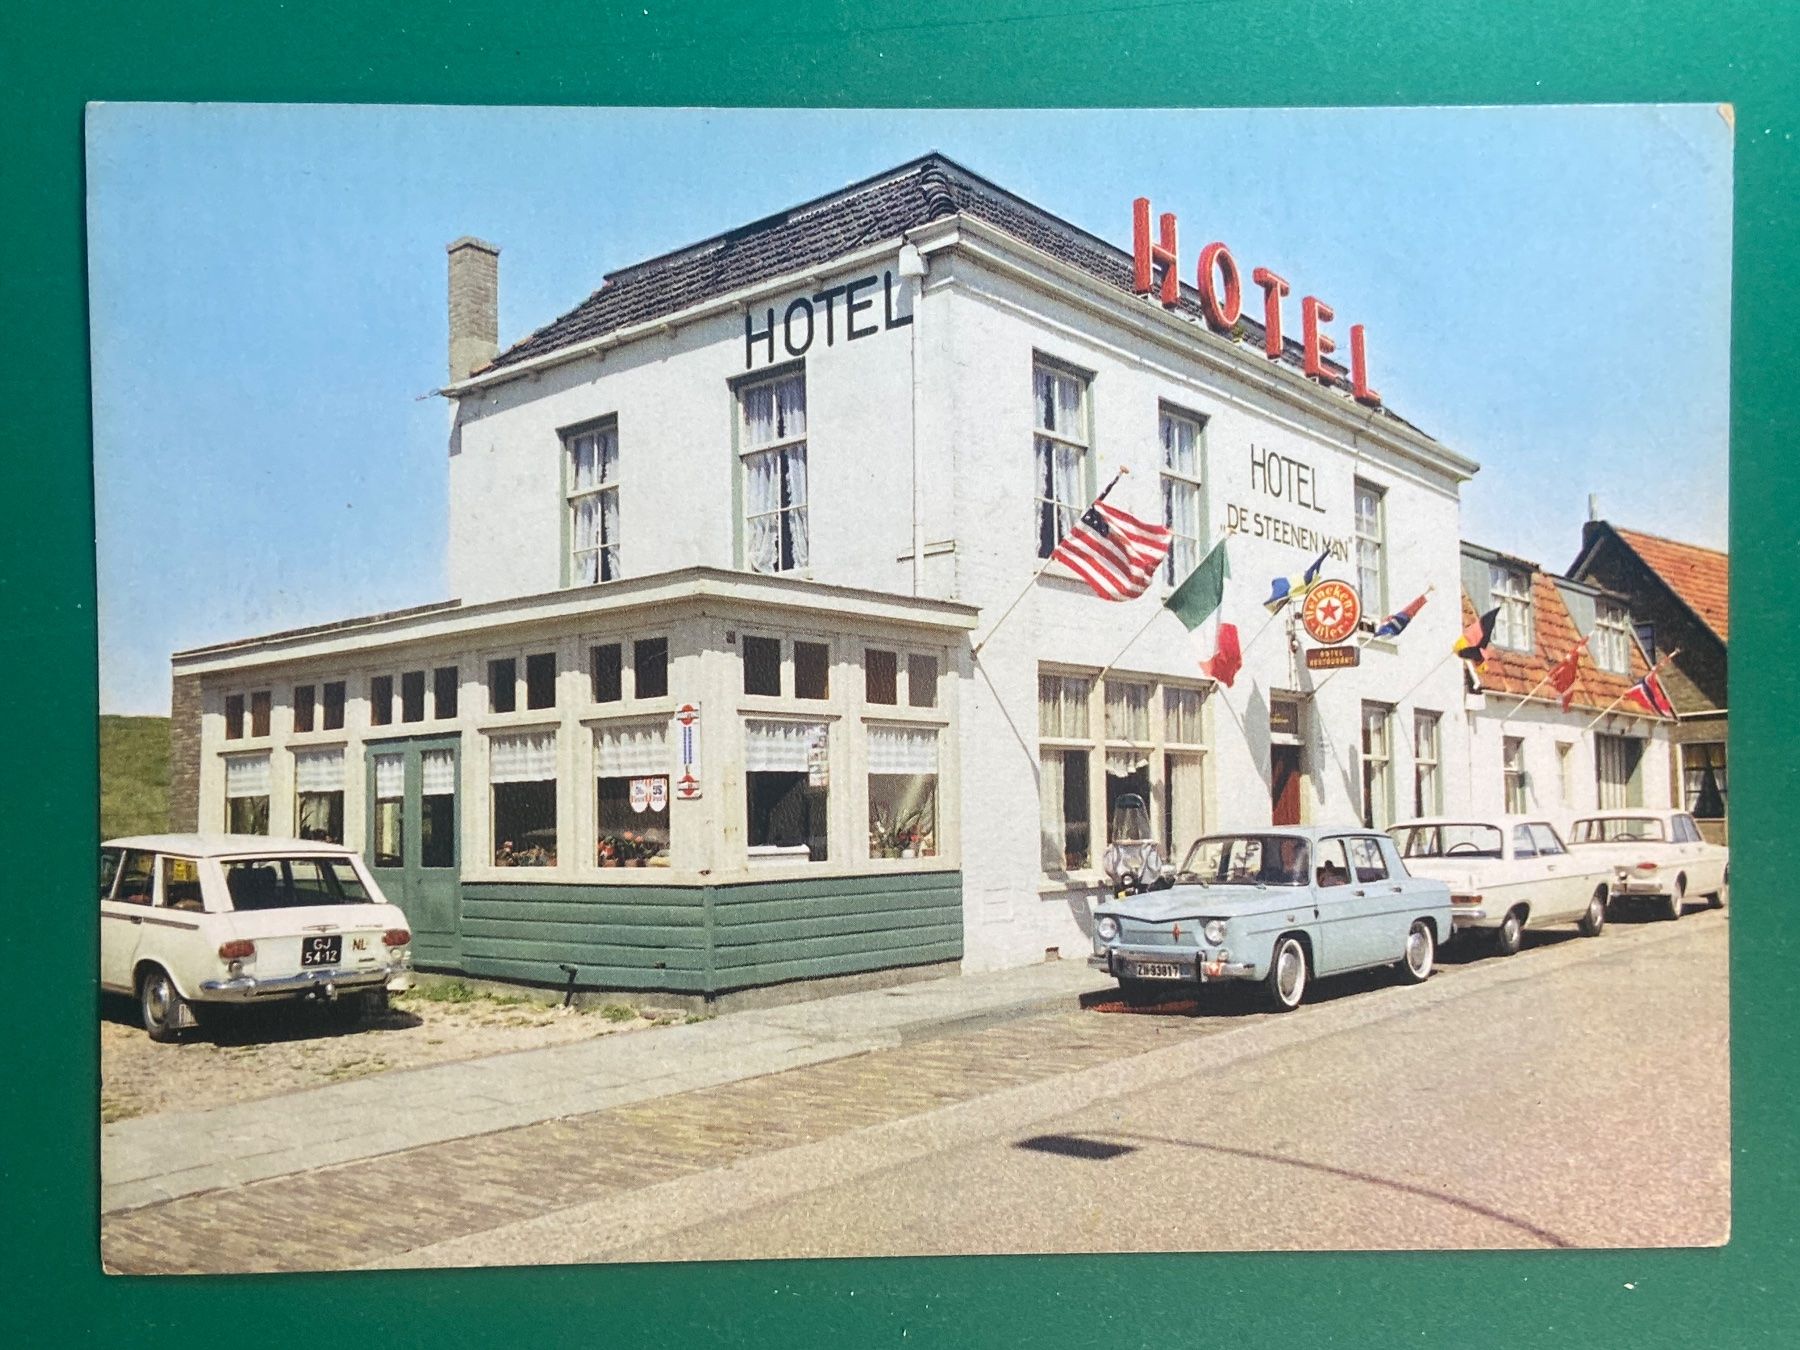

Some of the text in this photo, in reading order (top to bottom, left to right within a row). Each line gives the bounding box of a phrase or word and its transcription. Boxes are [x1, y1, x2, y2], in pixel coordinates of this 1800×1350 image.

[745, 270, 913, 369] HOTEL
[1132, 197, 1381, 407] HOTEL
[1251, 443, 1326, 513] HOTEL
[1253, 513, 1319, 553] STEENEN
[313, 938, 332, 950] GJ
[352, 937, 367, 951] NL
